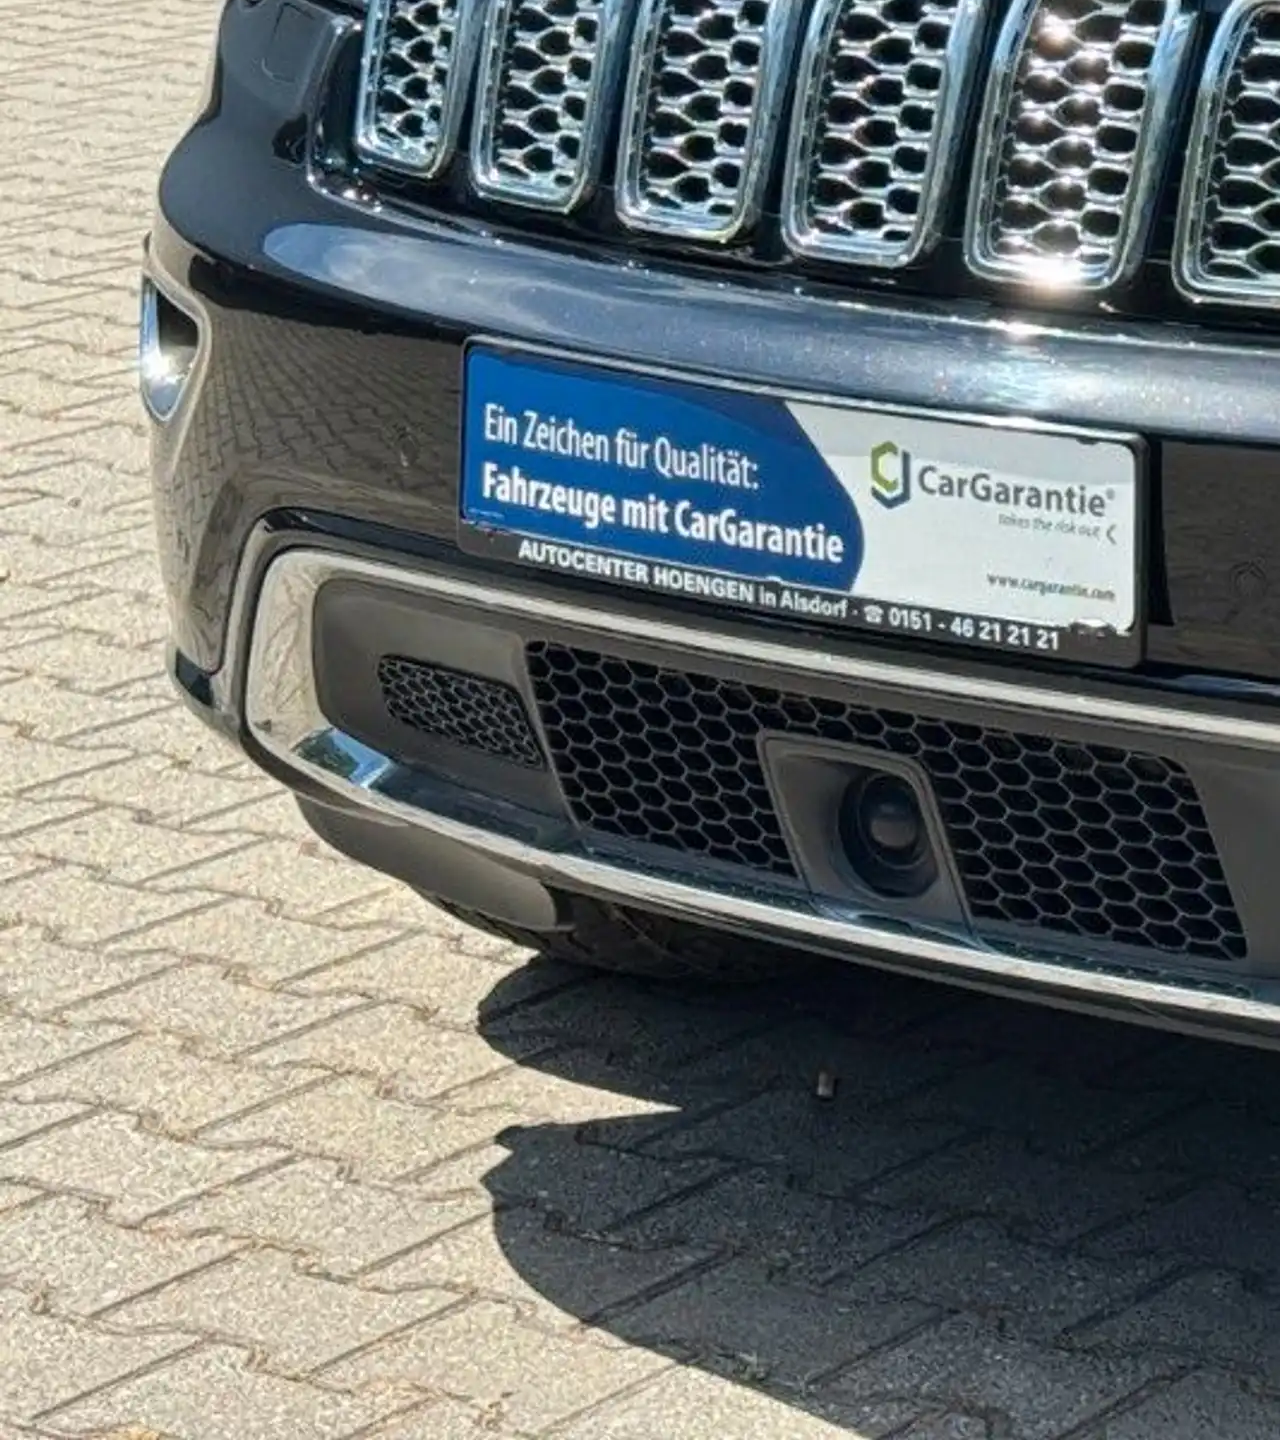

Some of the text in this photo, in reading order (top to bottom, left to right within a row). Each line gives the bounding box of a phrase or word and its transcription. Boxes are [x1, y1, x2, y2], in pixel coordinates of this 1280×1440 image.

[484, 403, 759, 490] Ein Zeichen für Qualität:
[483, 461, 844, 563] Fahrzeuge mit CarGarantie
[998, 512, 1030, 529] takes
[1033, 517, 1053, 532] the
[1055, 519, 1076, 534] risk
[518, 539, 649, 584] AUTOCENTER
[653, 565, 754, 602] HOENGEN
[780, 590, 849, 619] Alsdorf
[888, 609, 932, 632] 0151
[951, 617, 974, 638] 46
[979, 620, 1001, 642] 21
[1008, 624, 1030, 646] 21
[1036, 629, 1060, 651] 21
[987, 573, 1116, 601] www.cargarantie.com
